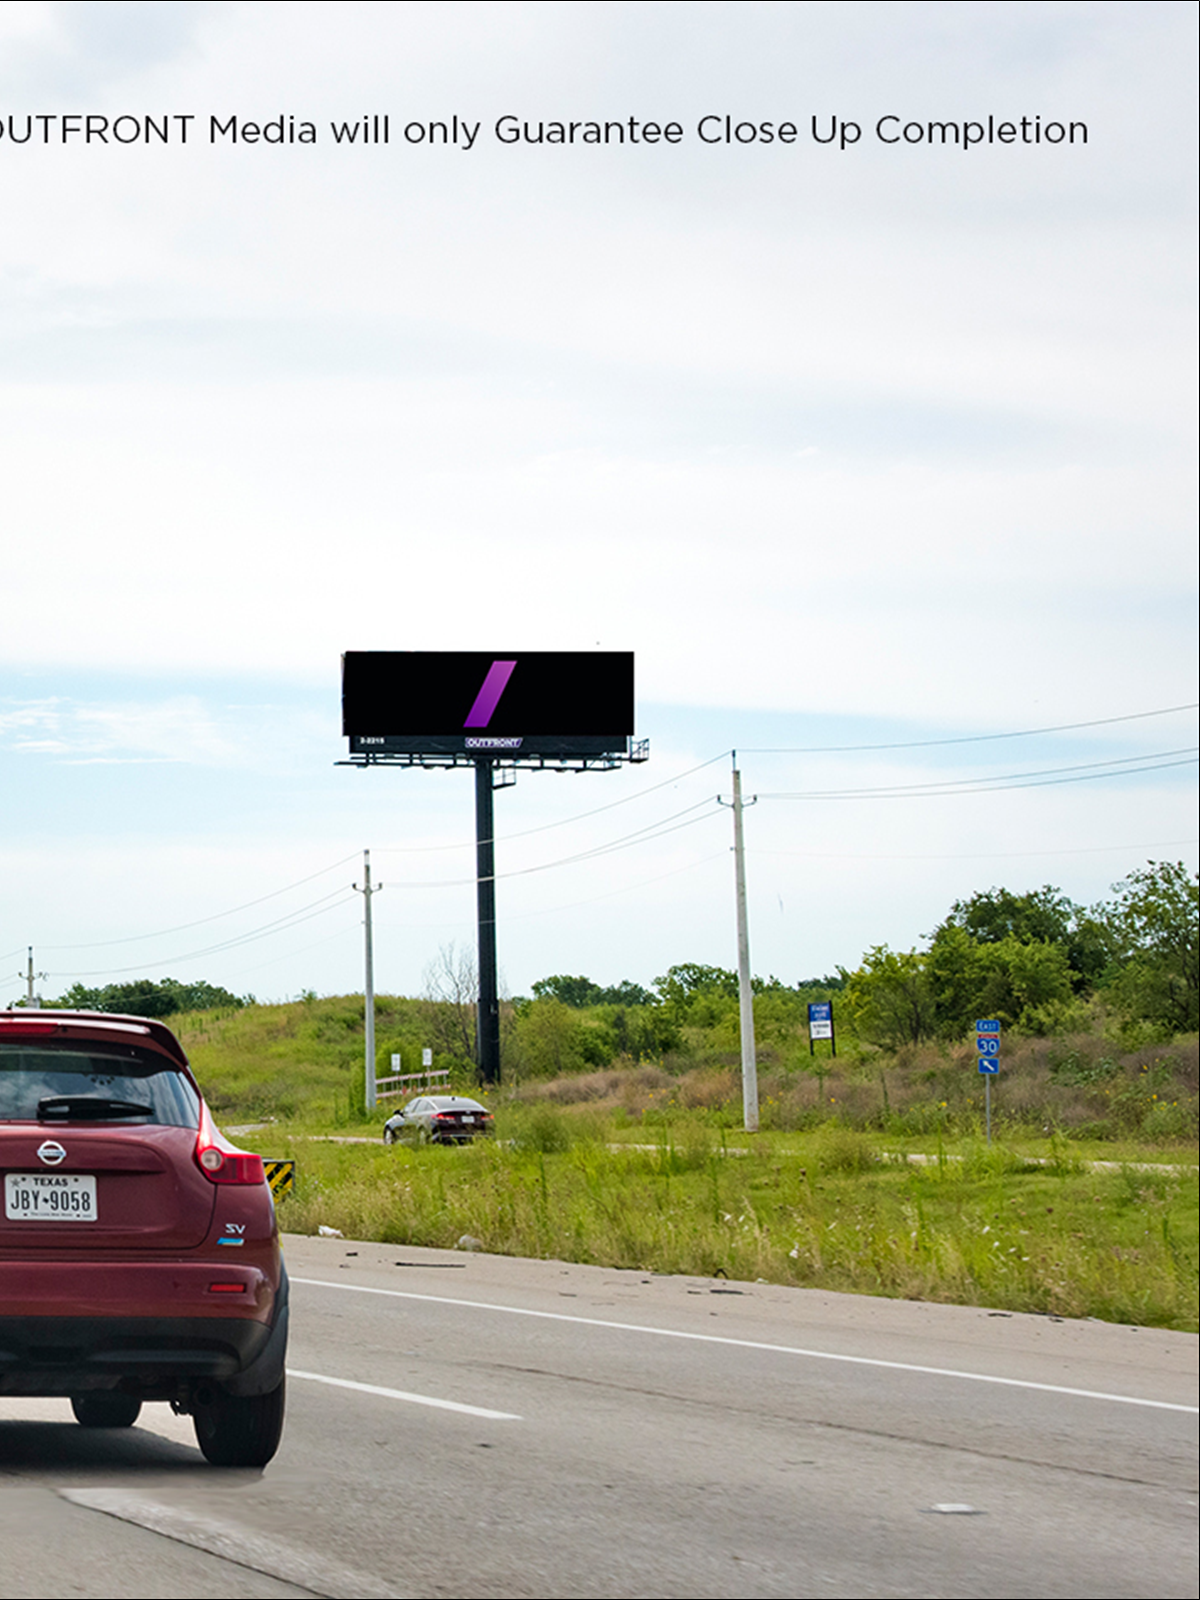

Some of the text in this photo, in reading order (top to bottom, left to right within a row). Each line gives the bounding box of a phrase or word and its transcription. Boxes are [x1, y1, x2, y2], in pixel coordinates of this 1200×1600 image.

[466, 738, 518, 747] OUTFRONT
[978, 1021, 997, 1030] EAST
[980, 1040, 997, 1053] 30
[33, 1177, 68, 1187] TEXAS
[225, 1223, 246, 1234] SV
